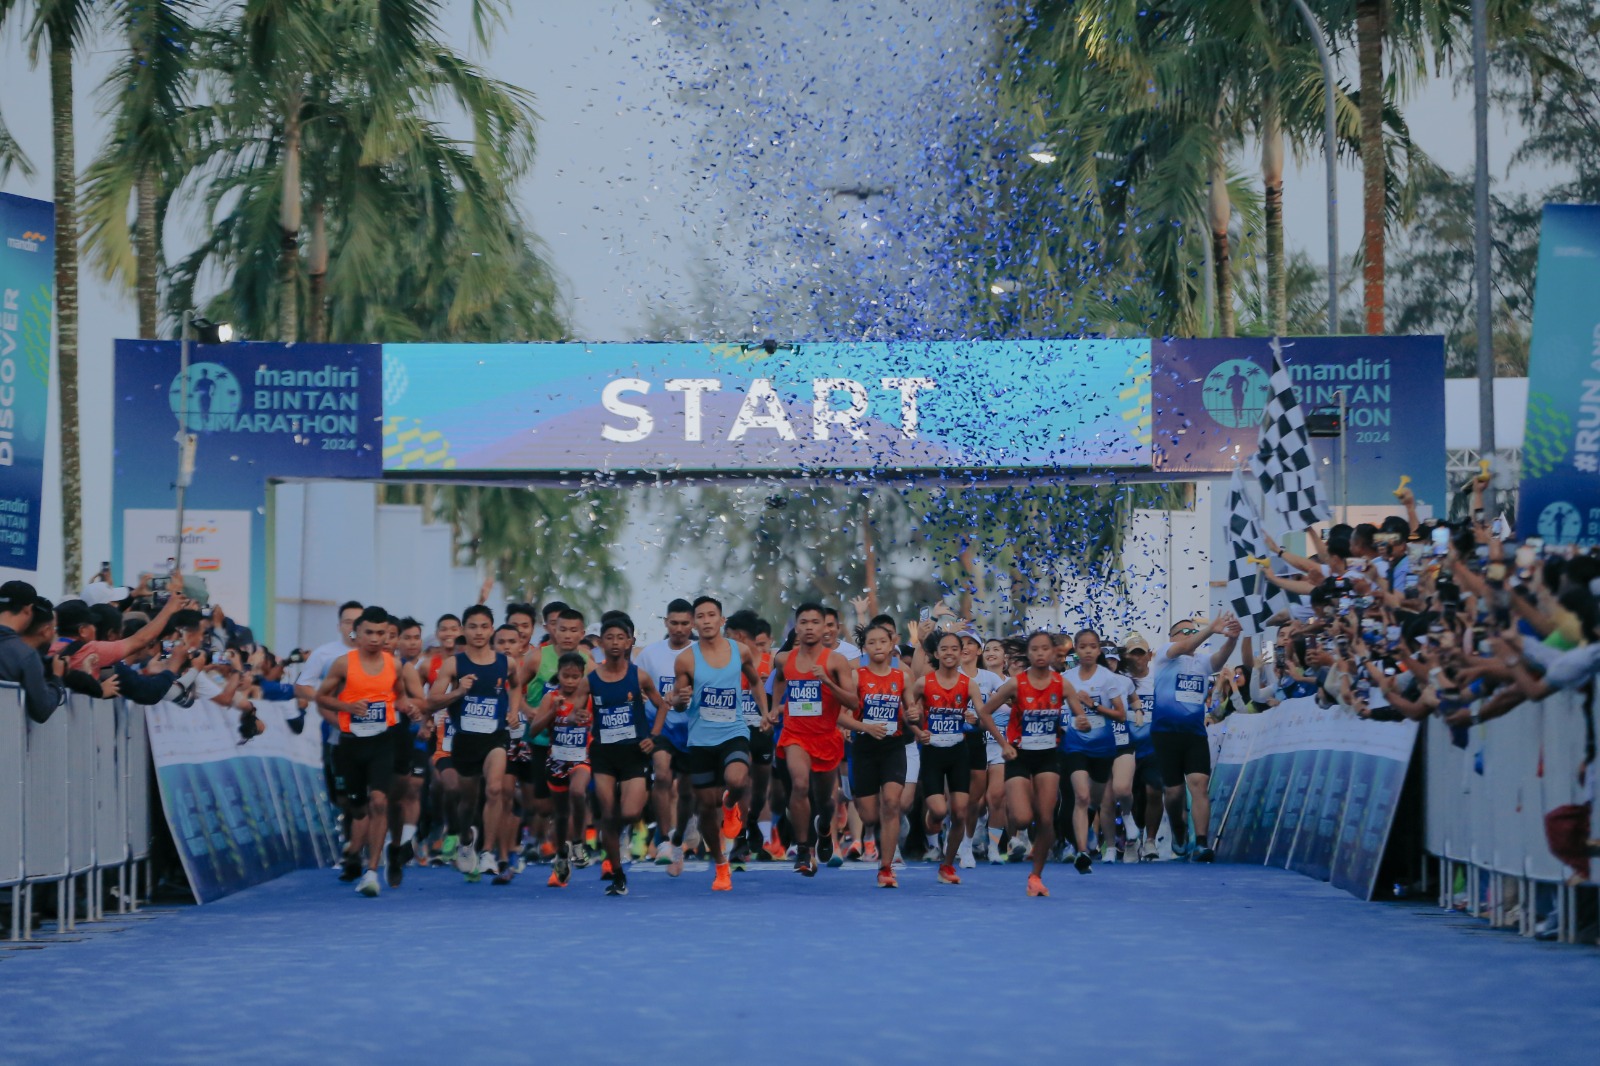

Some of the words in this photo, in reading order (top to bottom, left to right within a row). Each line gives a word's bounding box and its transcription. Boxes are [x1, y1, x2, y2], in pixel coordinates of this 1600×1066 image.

[1287, 357, 1391, 380] mandiri
[0, 287, 20, 467] DISCOVER
[254, 365, 359, 387] mandiri
[254, 391, 359, 410] BINTAN
[1290, 384, 1391, 405] BINTAN
[601, 378, 936, 442] START
[216, 414, 359, 434] MARATHON
[321, 438, 357, 450] 2024
[1356, 432, 1390, 443] 2024
[1178, 680, 1201, 690] 40281
[790, 687, 818, 699] 40489
[863, 693, 900, 702] KEPRI
[704, 694, 734, 706] 40470
[464, 702, 495, 717] 40579
[867, 706, 895, 719] 40220
[602, 713, 630, 726] 40580
[931, 720, 959, 732] 40221
[1025, 721, 1055, 734] 40219
[555, 733, 584, 745] 40213
